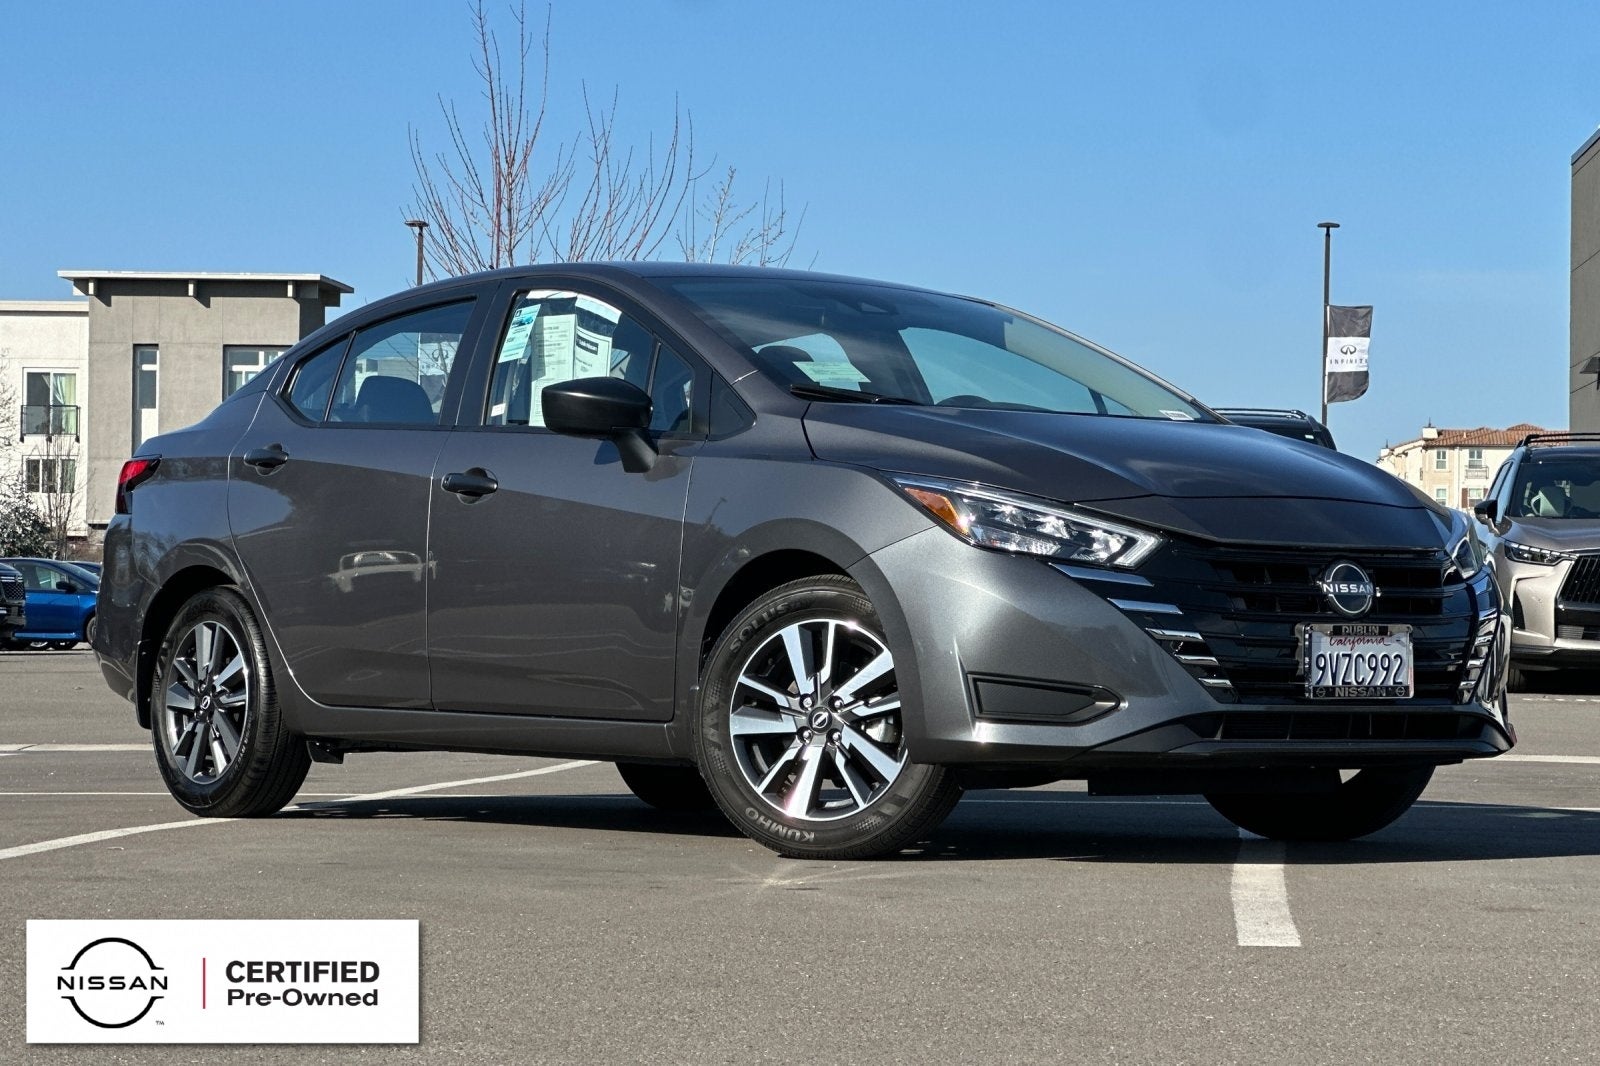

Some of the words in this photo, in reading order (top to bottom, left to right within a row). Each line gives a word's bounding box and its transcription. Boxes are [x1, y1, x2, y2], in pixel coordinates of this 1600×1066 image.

[1322, 583, 1374, 594] NISSAN
[730, 602, 789, 653] SOLUS
[1342, 625, 1380, 636] DUBLIN
[1329, 635, 1391, 651] California
[1315, 652, 1404, 686] 9VZC992
[1335, 686, 1386, 697] NISSAN
[745, 807, 815, 843] KUMHO
